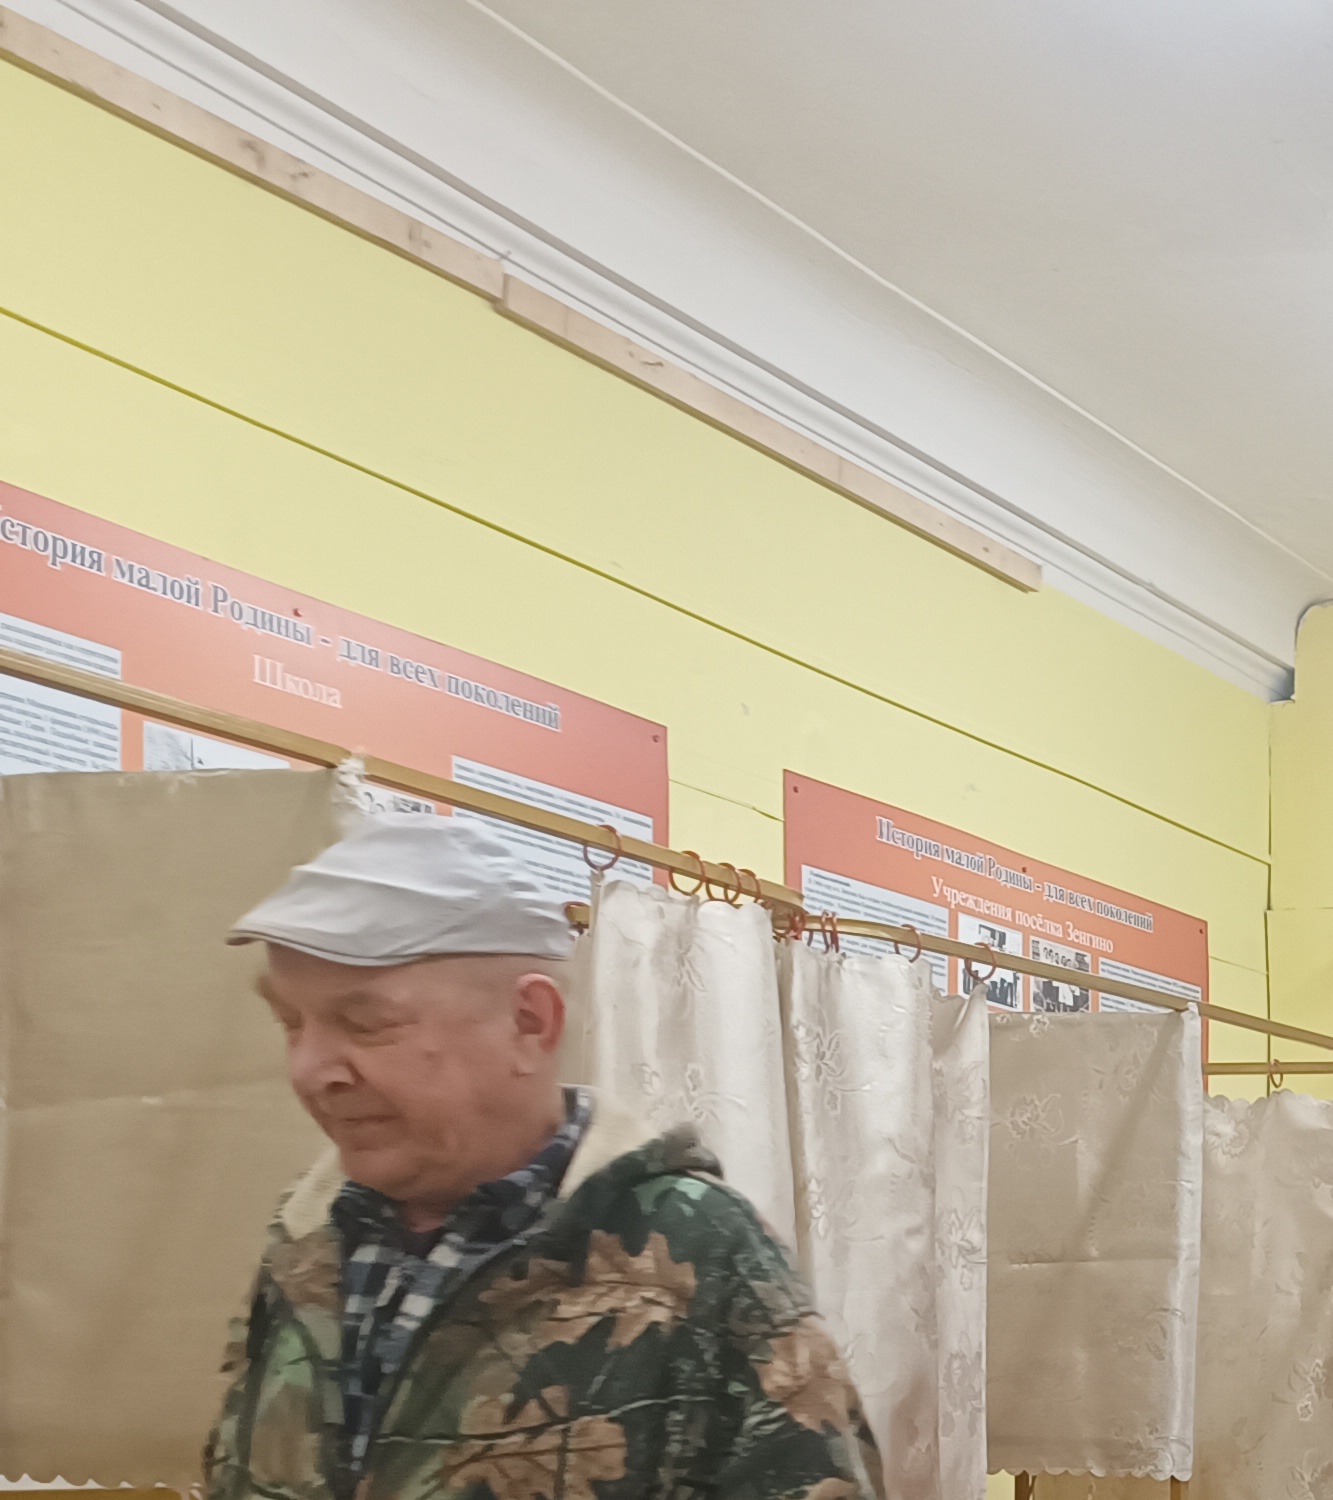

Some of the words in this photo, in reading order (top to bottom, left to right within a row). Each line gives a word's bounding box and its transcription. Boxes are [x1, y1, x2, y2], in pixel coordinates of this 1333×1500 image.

[0, 516, 105, 575] стория
[112, 556, 202, 610] малой
[209, 583, 314, 647] Родины
[337, 636, 382, 672] для
[387, 652, 442, 690] всех
[446, 673, 561, 732] поколений
[252, 654, 343, 708] Школа
[875, 816, 942, 861] История
[942, 846, 984, 875] малой
[986, 855, 1034, 893] Родины
[1043, 882, 1067, 903] для
[1095, 899, 1154, 933] поколений
[930, 875, 1013, 923] Учреждения
[1015, 909, 1063, 938] посёлка
